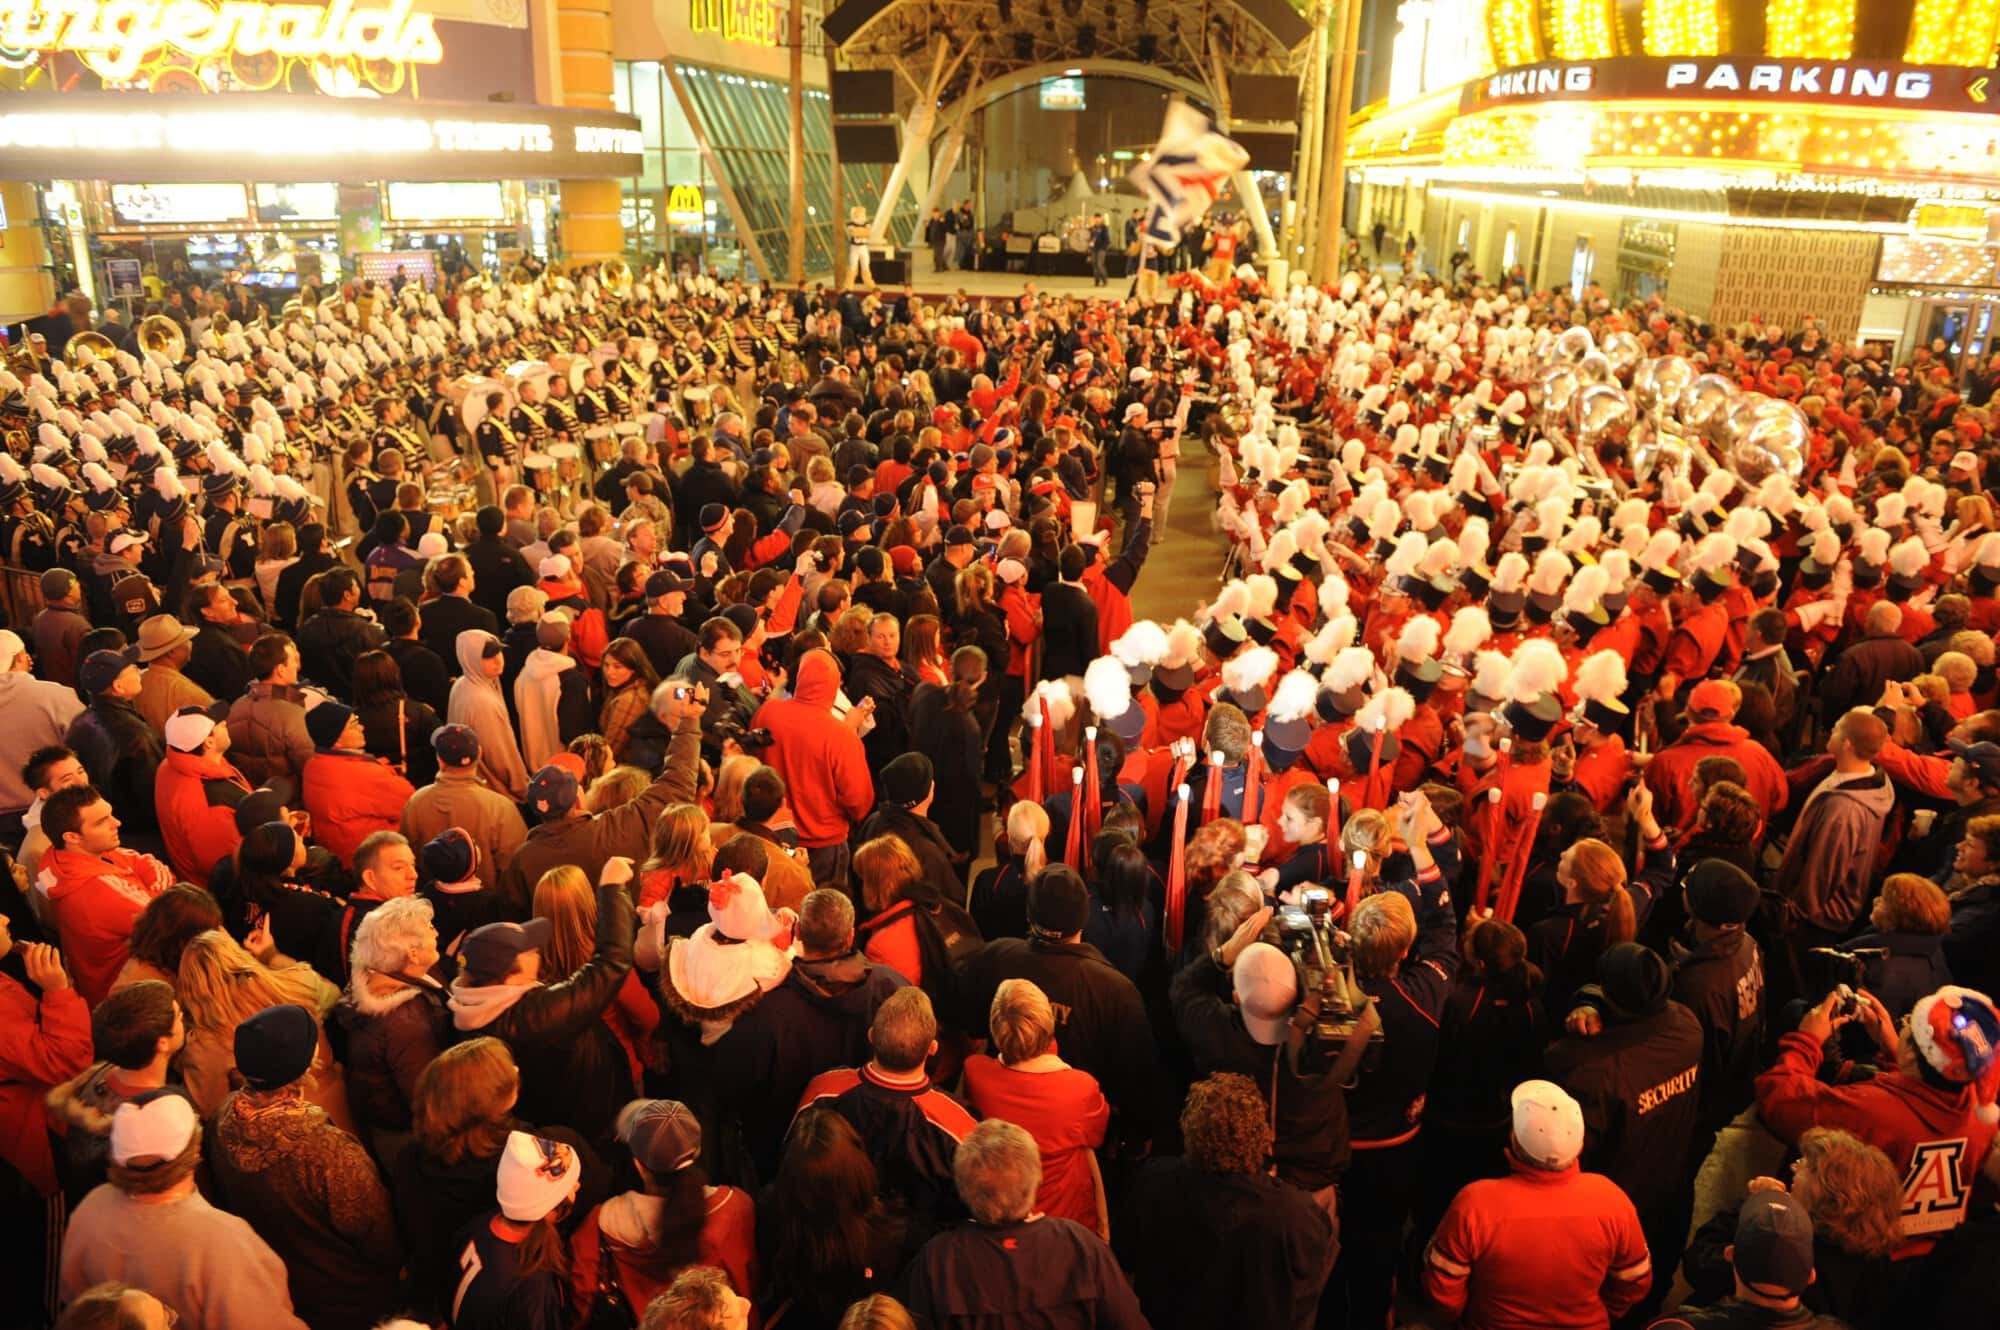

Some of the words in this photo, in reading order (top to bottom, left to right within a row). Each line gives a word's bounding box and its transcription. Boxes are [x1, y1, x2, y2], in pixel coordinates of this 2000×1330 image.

[1666, 63, 1932, 100] PARKING
[1638, 1063, 1698, 1115] SECURITY
[452, 1239, 483, 1328] 7
